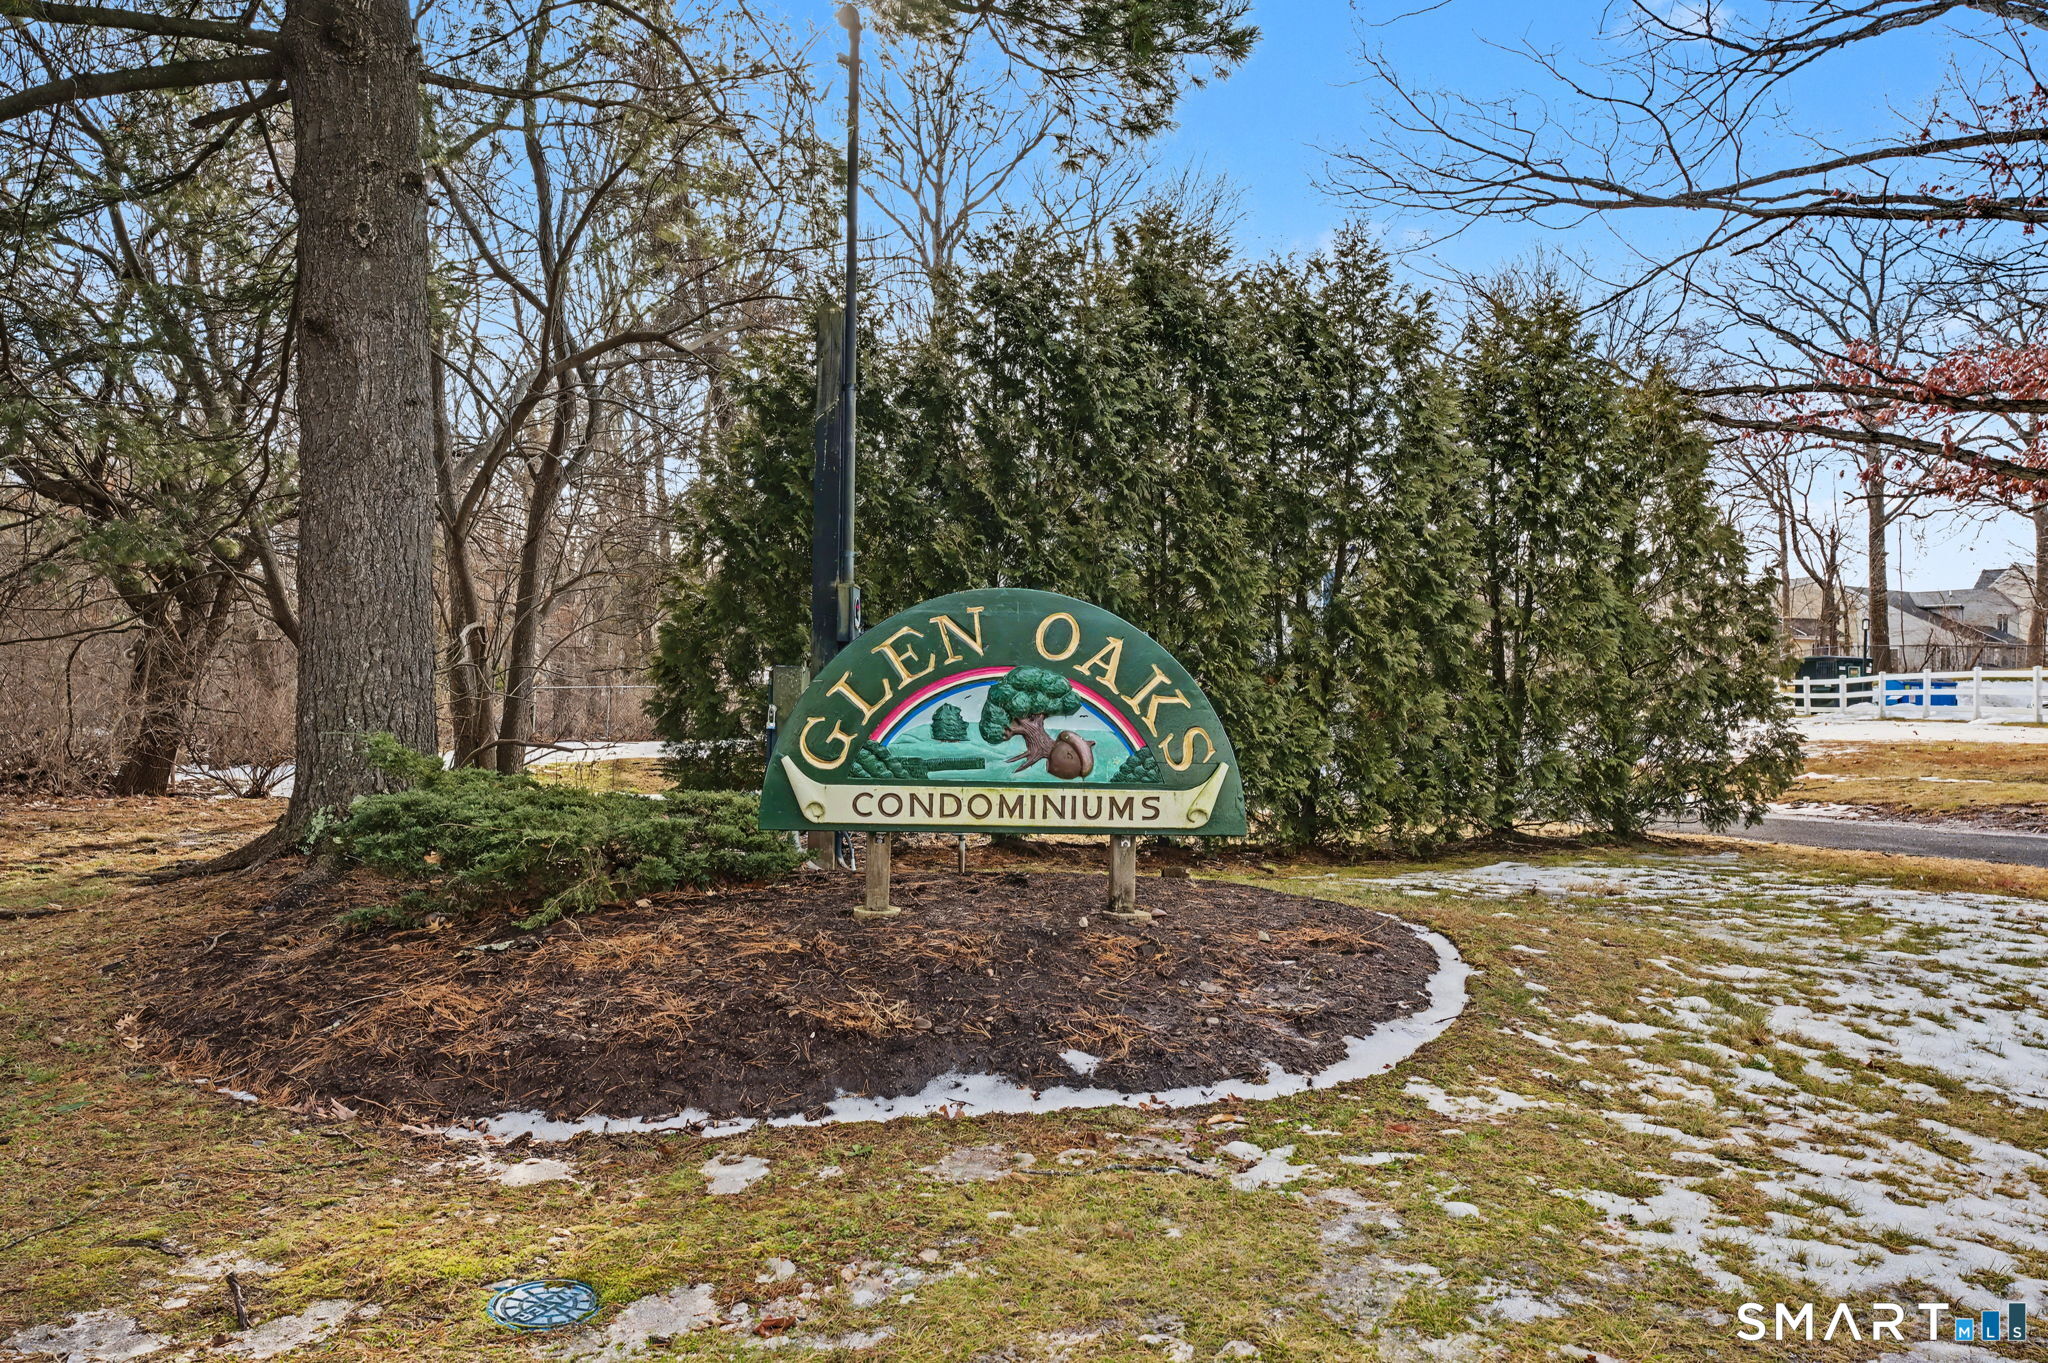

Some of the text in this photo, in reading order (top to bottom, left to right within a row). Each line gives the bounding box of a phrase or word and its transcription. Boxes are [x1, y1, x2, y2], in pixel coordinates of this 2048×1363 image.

[799, 606, 1216, 772] GLEN OAKS
[851, 791, 1161, 821] CONDOMINIUMS
